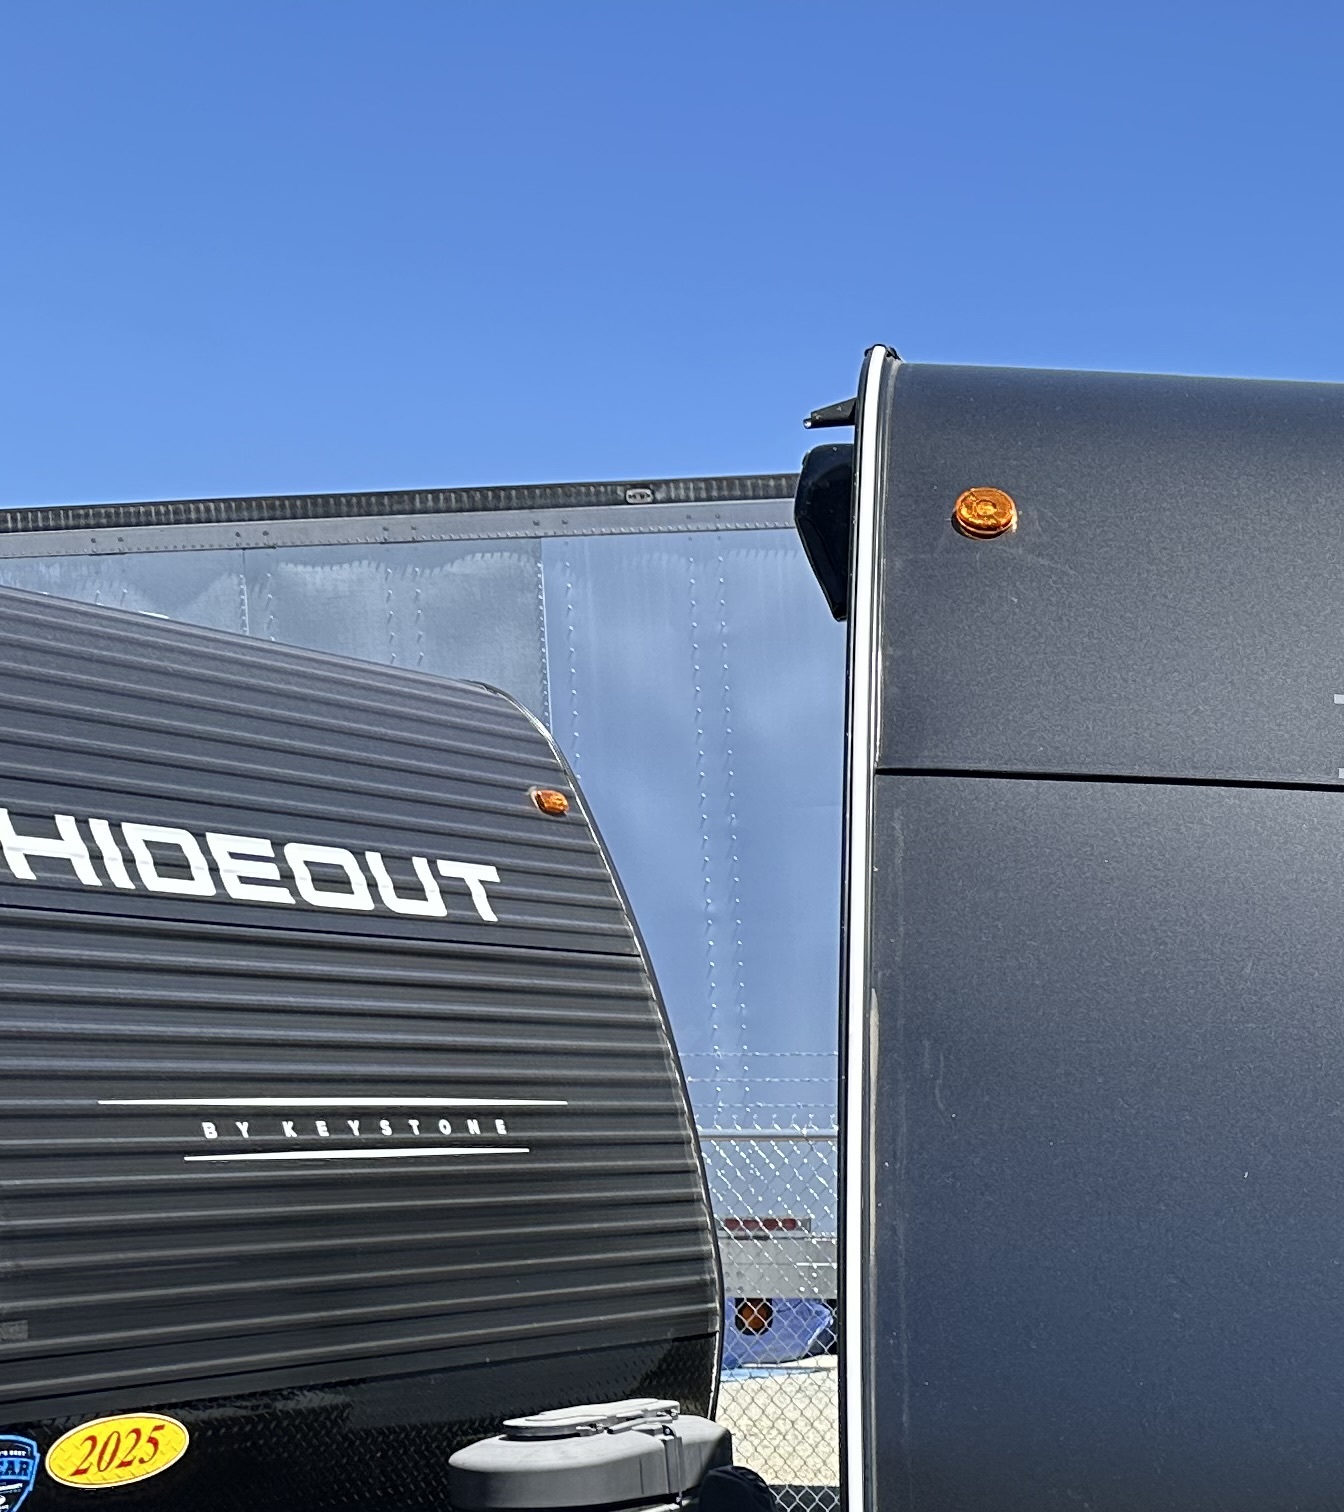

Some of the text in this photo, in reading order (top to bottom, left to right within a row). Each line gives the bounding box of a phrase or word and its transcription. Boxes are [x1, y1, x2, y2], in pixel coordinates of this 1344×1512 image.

[0, 808, 501, 922] HIDEOUT
[202, 1119, 509, 1139] BY KEYSTONE
[69, 1425, 166, 1477] 2025
